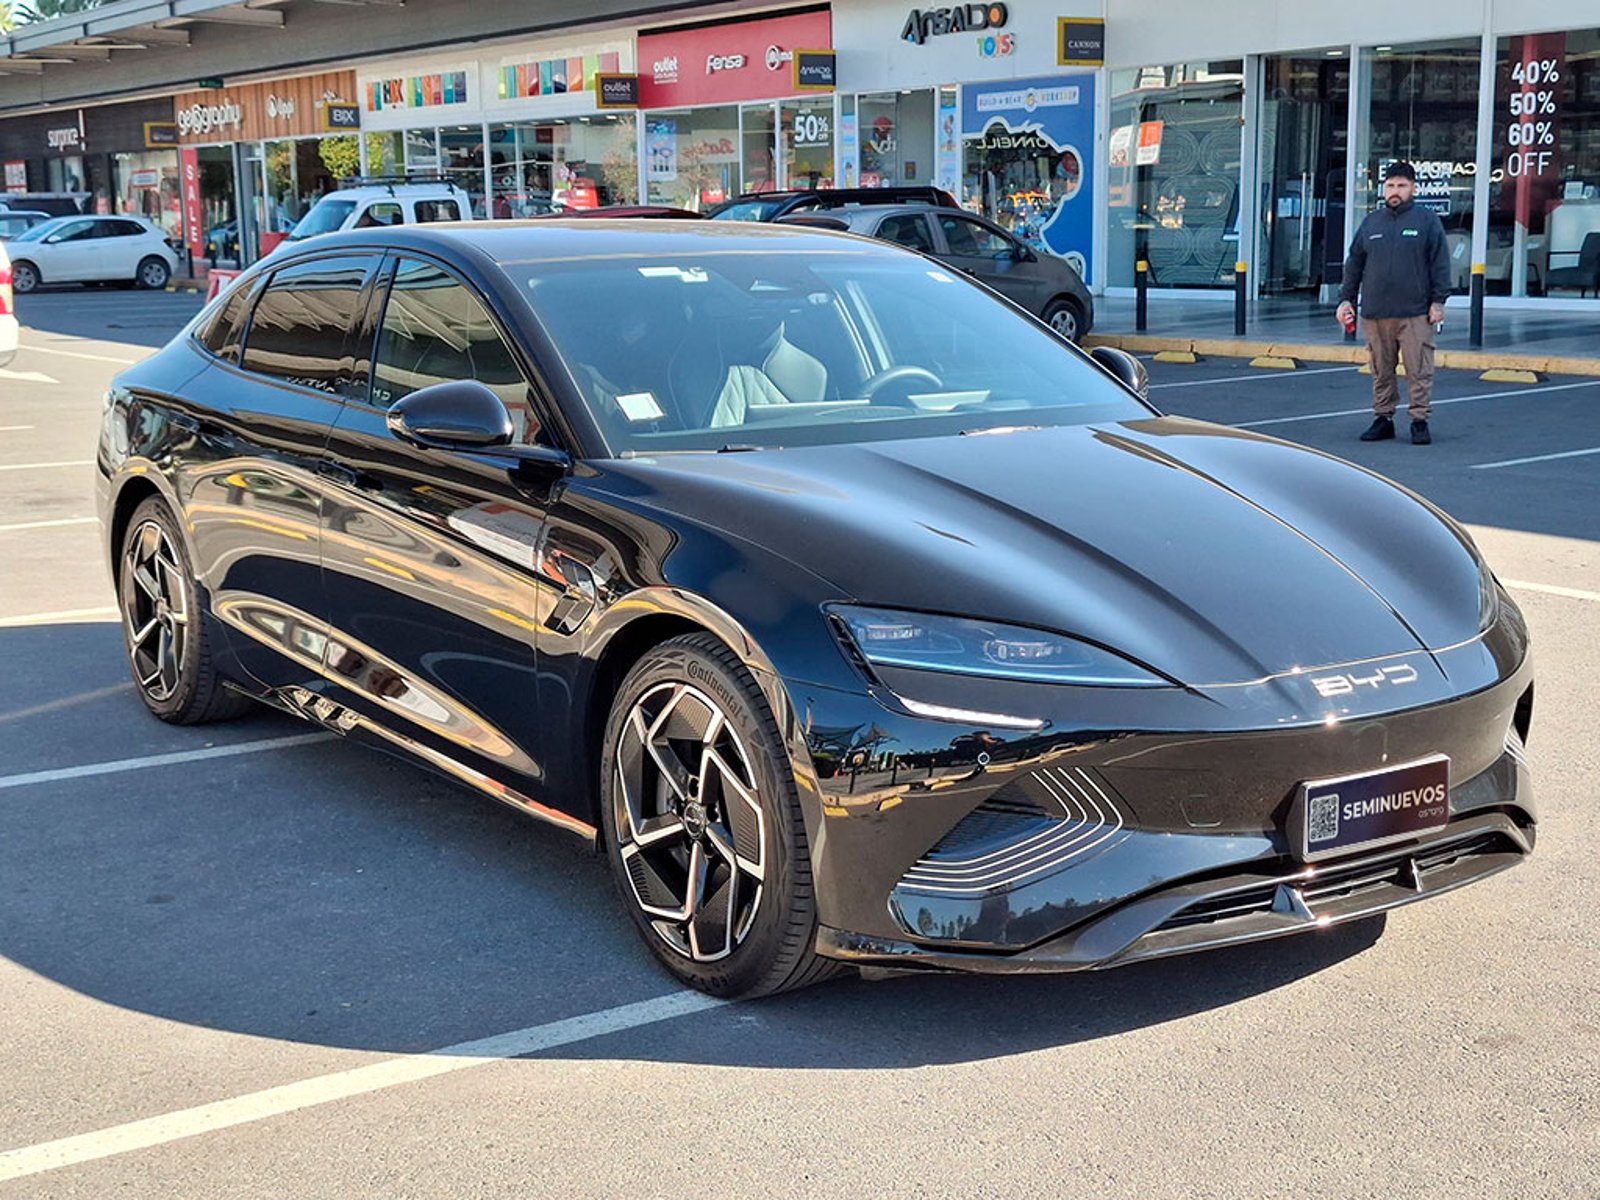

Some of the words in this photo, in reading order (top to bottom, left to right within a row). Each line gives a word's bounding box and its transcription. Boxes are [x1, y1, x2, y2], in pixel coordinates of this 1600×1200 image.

[1068, 40, 1101, 49] CANNON
[653, 57, 678, 73] outlet
[706, 54, 746, 75] fensa
[1511, 59, 1559, 85] 40%
[603, 82, 631, 92] outlet
[1510, 90, 1556, 116] 50%
[1508, 121, 1554, 146] 60%
[1507, 151, 1553, 177] OFF
[186, 164, 199, 242] SALE
[687, 660, 743, 717] Continental
[1311, 663, 1419, 697] BYD
[1343, 784, 1446, 821] SEMINUEVOS
